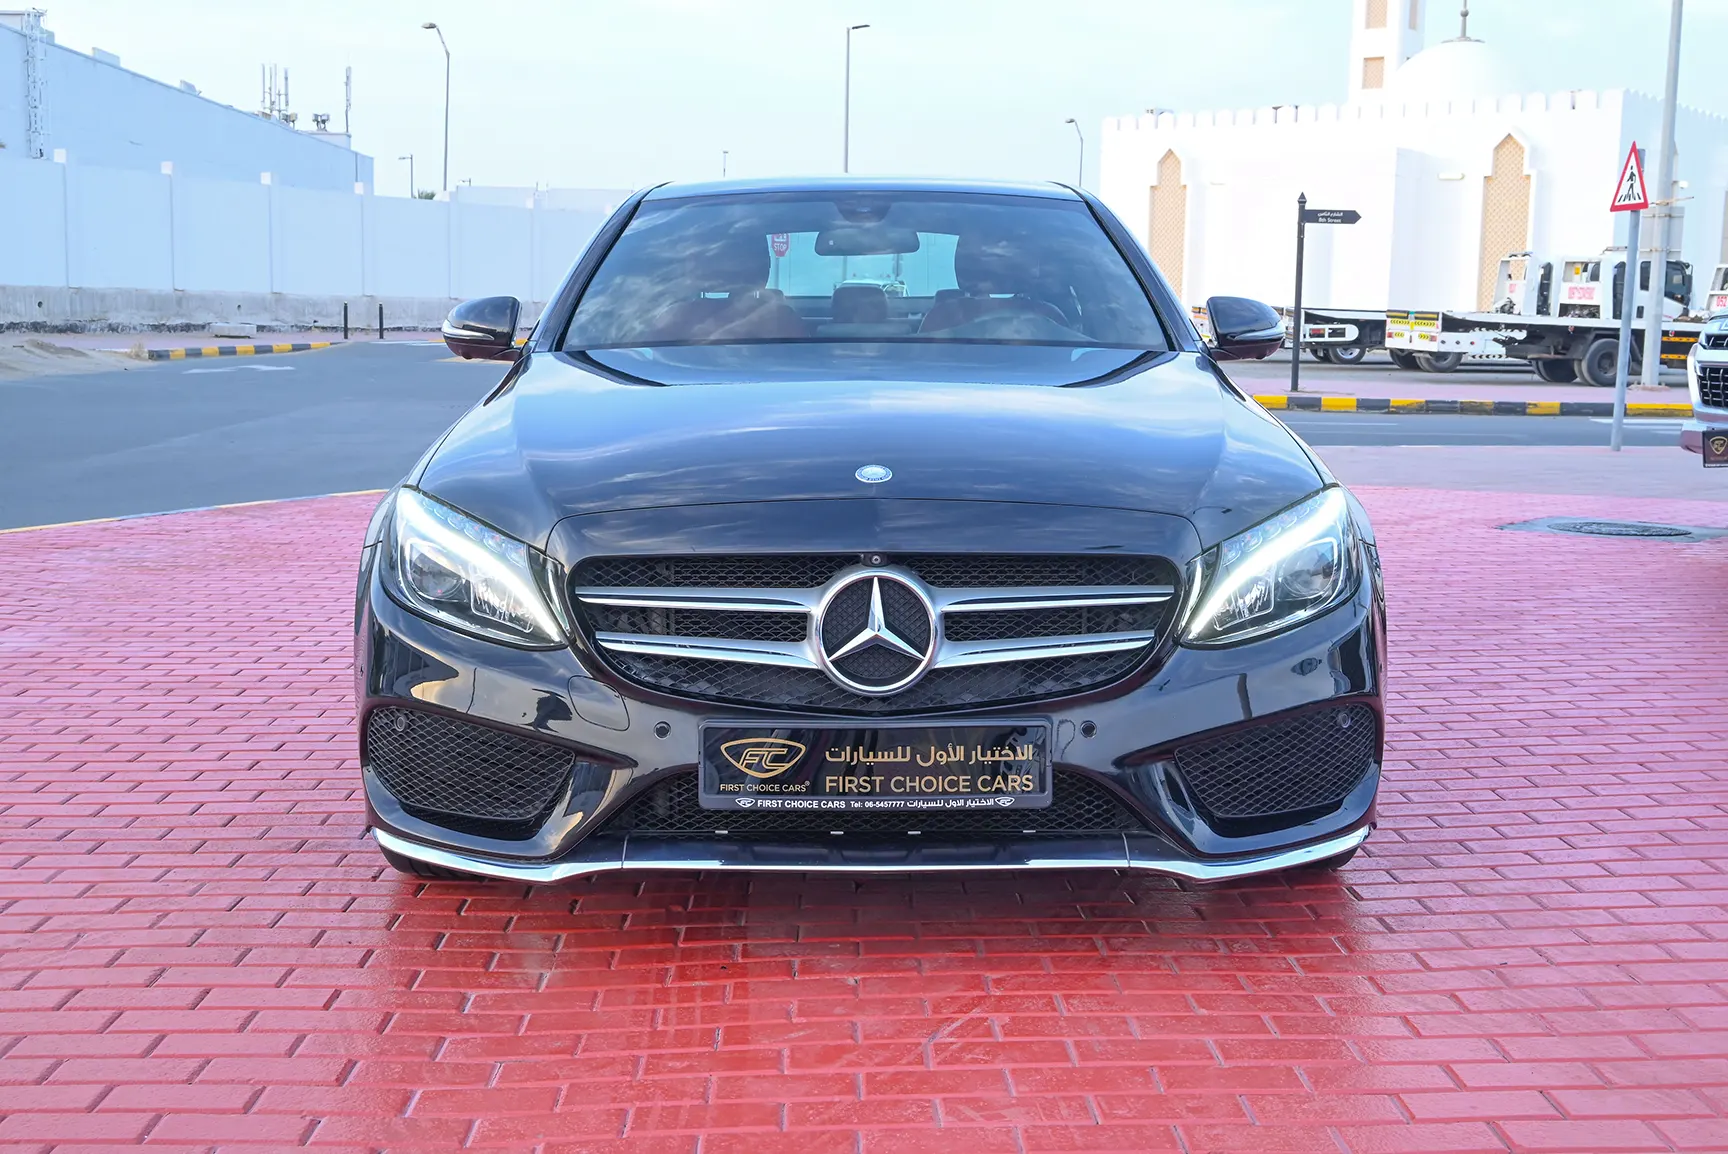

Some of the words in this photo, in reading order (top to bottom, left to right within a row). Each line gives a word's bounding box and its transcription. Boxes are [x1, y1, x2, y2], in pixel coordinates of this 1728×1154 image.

[774, 243, 787, 252] STOP
[825, 746, 911, 766] للسيارات
[916, 743, 965, 767] الأول
[969, 744, 1033, 765] الاختيار
[720, 784, 744, 792] FIRST
[746, 784, 780, 792] CHOICE
[825, 776, 885, 793] FIRST
[890, 776, 971, 793] CHOICE
[977, 775, 1034, 792] CARS
[757, 800, 782, 808] FIRST
[784, 800, 819, 808] CHOICE
[821, 800, 846, 809] CARS
[864, 800, 905, 808] 06-5457777
[907, 799, 943, 809] للسيارات
[965, 798, 994, 808] الاختيار
